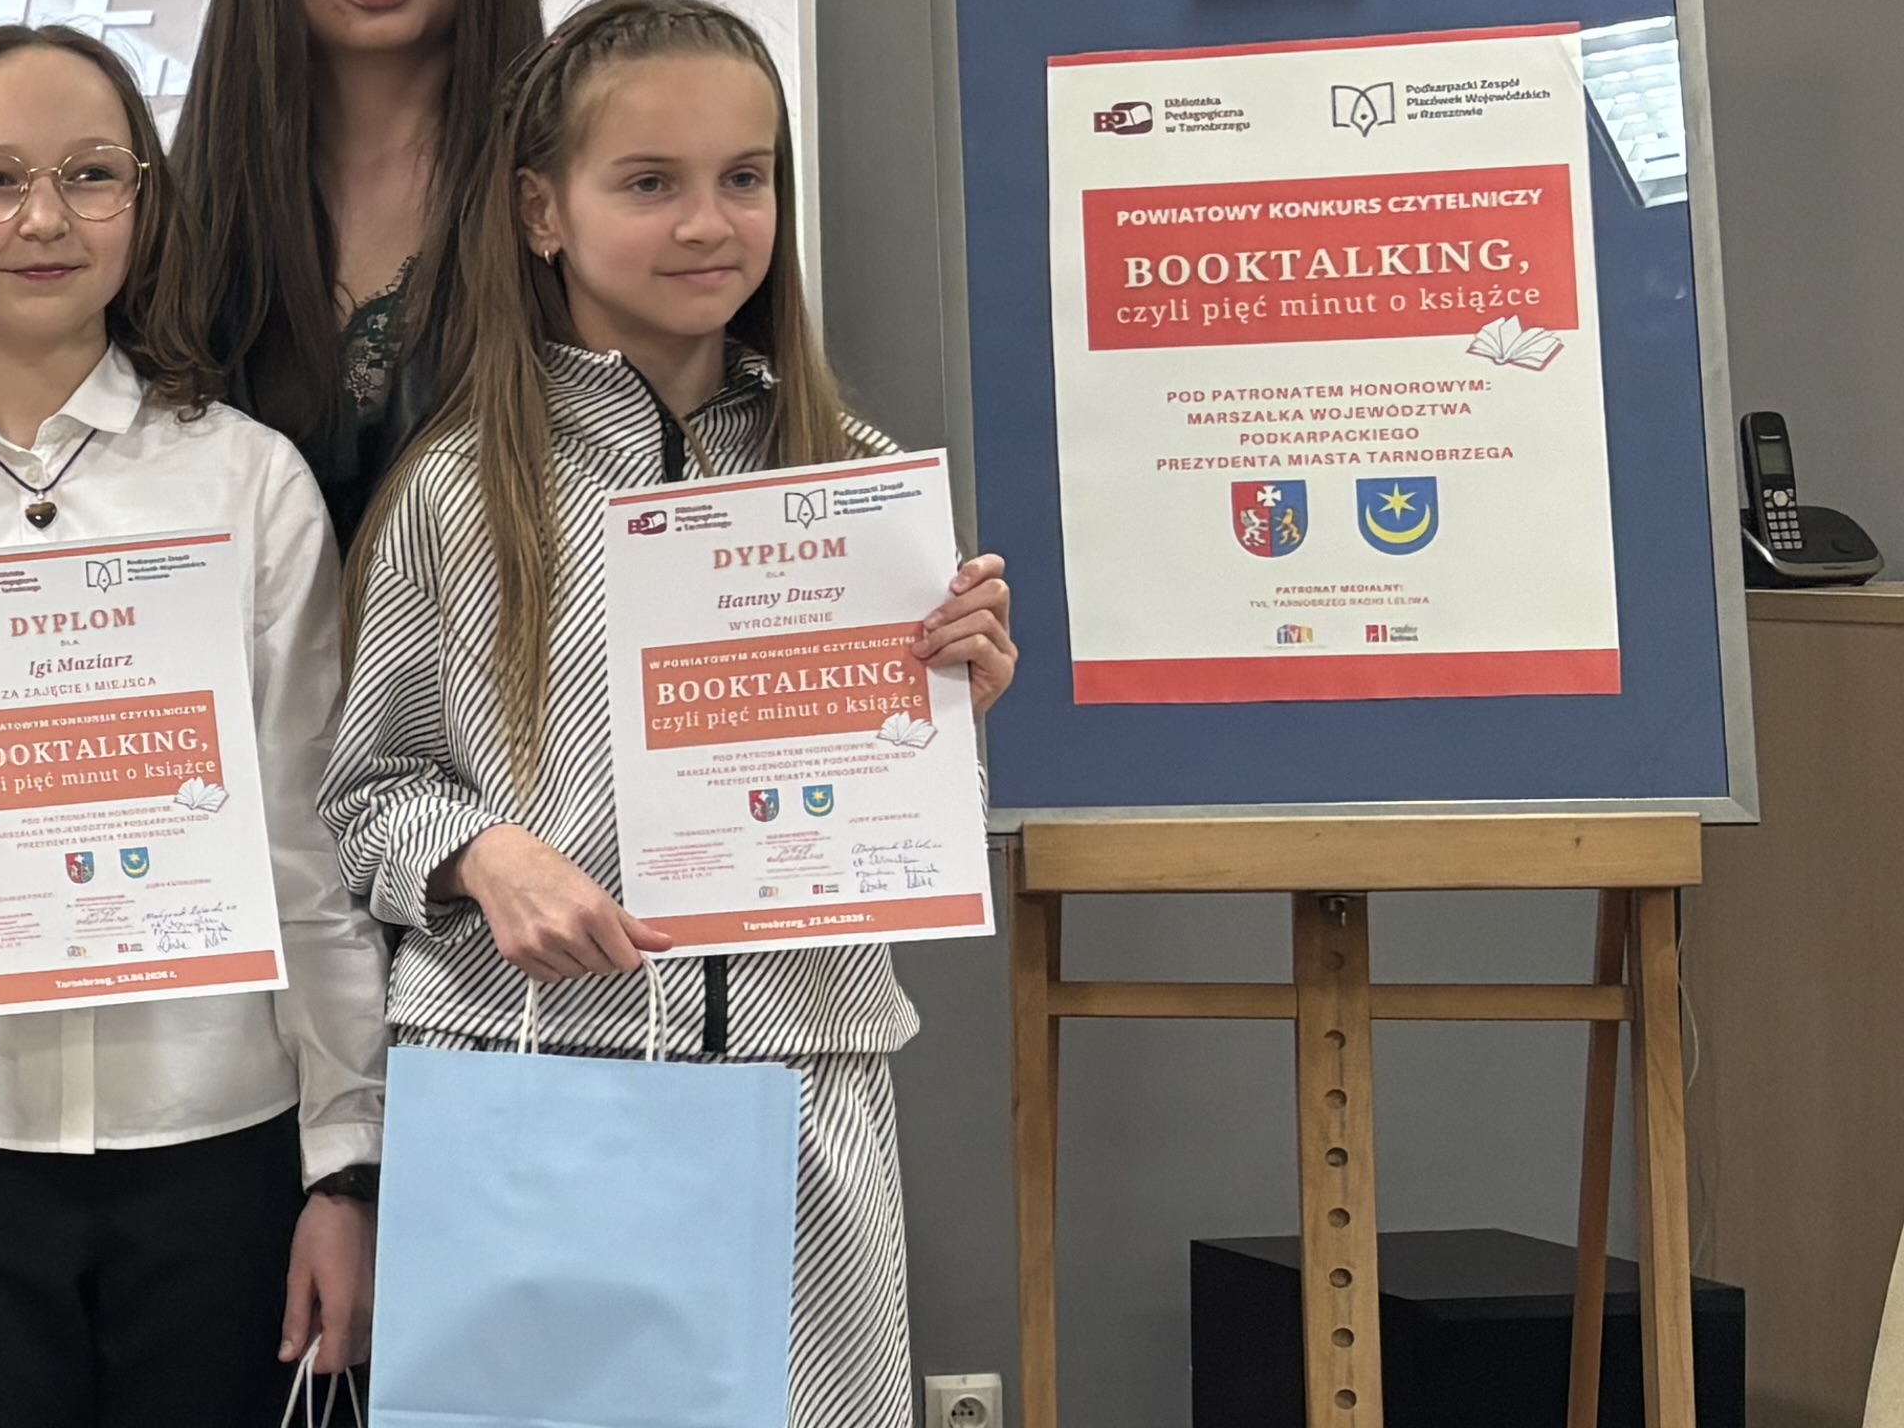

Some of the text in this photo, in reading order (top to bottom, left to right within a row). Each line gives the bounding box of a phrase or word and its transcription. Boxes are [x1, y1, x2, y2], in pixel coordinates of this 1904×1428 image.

[1118, 189, 1541, 226] POWIATOWY KONKURS CZYTELNICZY
[1125, 239, 1528, 287] BOOKTALKING,
[1117, 284, 1539, 327] czyli pięć minut o książce
[1168, 380, 1491, 402] POD PATRONATEM HONOROWYM:
[1188, 403, 1471, 424] MARSZAŁKA WOJEWÓDZTWA
[1240, 428, 1419, 445] PODKARPACKIEGO
[1157, 447, 1513, 470] PREZYDENTA MIASTA TARNOBRZEGA
[714, 537, 846, 569] DYPLOM
[718, 587, 845, 609] Hanny Duszy
[10, 607, 135, 636] DYPLOM
[729, 612, 832, 630] WYRÓŻNIENIE
[30, 654, 132, 678] Igi Maziarz
[658, 661, 915, 704] BOOKTALKING,
[652, 693, 922, 732] czyli pięć minut o książce
[15, 774, 53, 794] pięć
[62, 769, 118, 785] minut
[127, 769, 136, 779] o
[145, 760, 215, 782] książce
